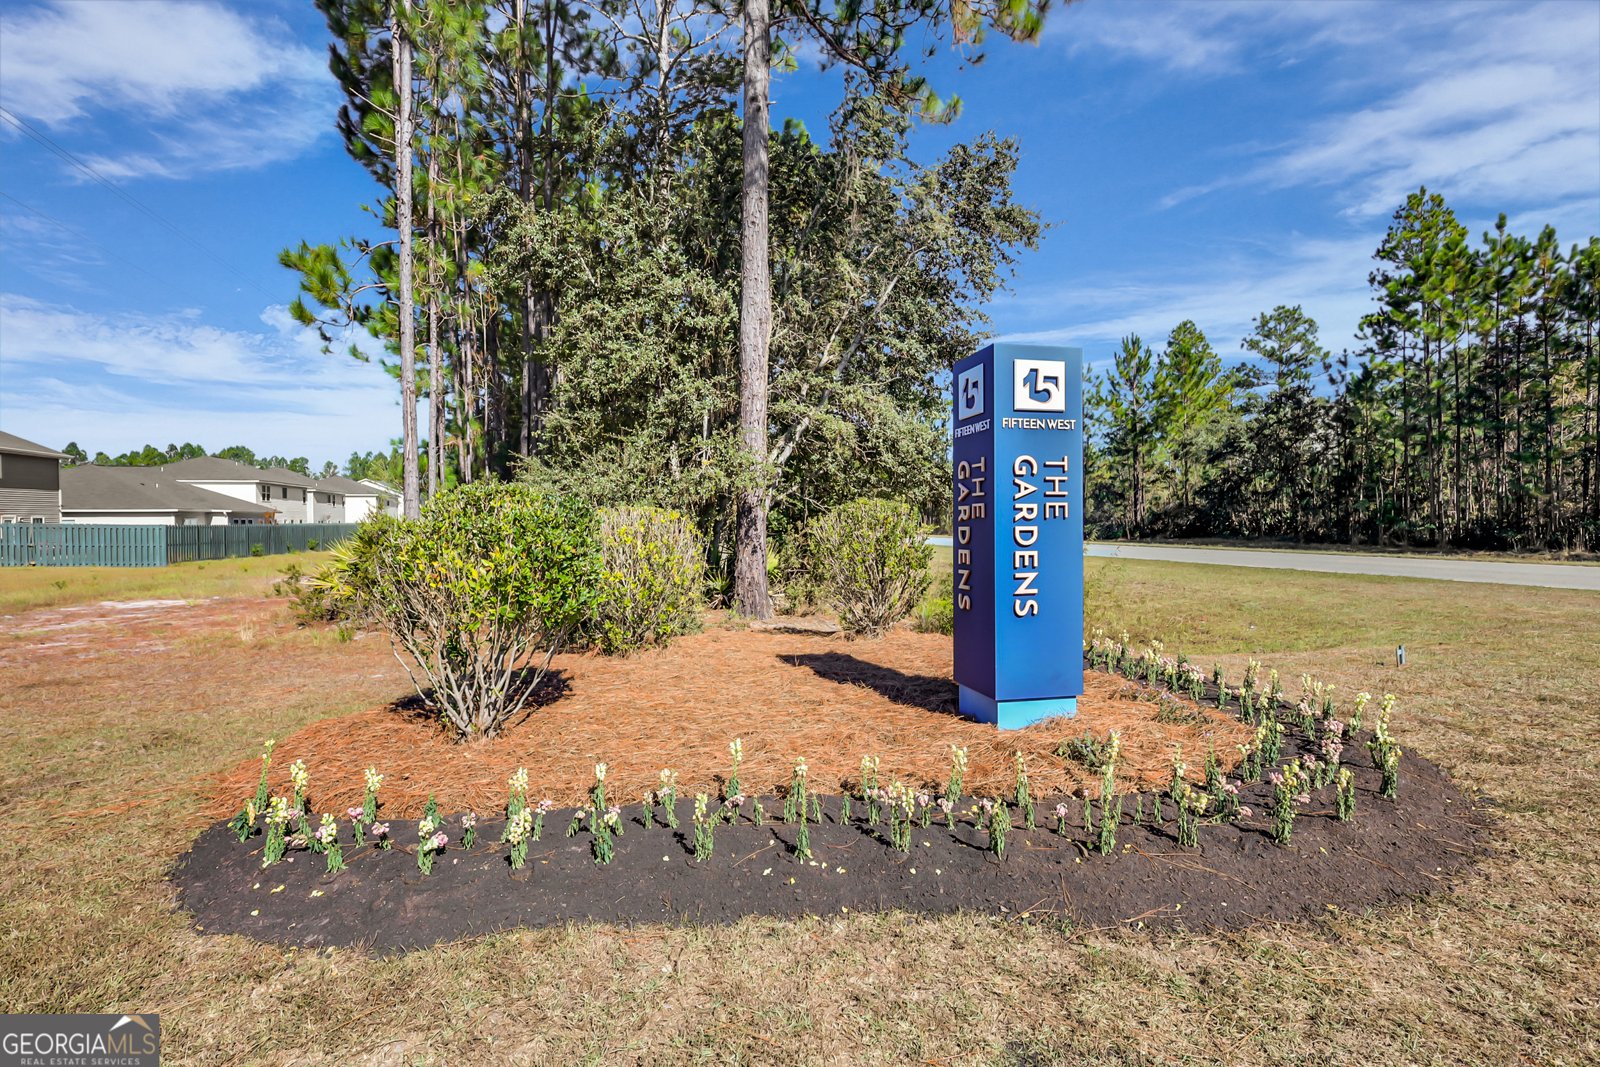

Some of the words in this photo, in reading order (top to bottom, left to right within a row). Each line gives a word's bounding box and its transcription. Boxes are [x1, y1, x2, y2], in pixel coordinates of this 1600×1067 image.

[962, 378, 979, 409] 15
[1022, 368, 1060, 403] 15
[954, 424, 975, 438] FIFTEEN
[975, 419, 991, 433] WEST
[1002, 417, 1045, 429] FIFTEEN
[1047, 419, 1076, 430] WEST
[971, 456, 986, 519] THE
[1045, 455, 1069, 518] THE
[957, 460, 971, 611] GARDENS
[1014, 454, 1039, 617] GARDENS
